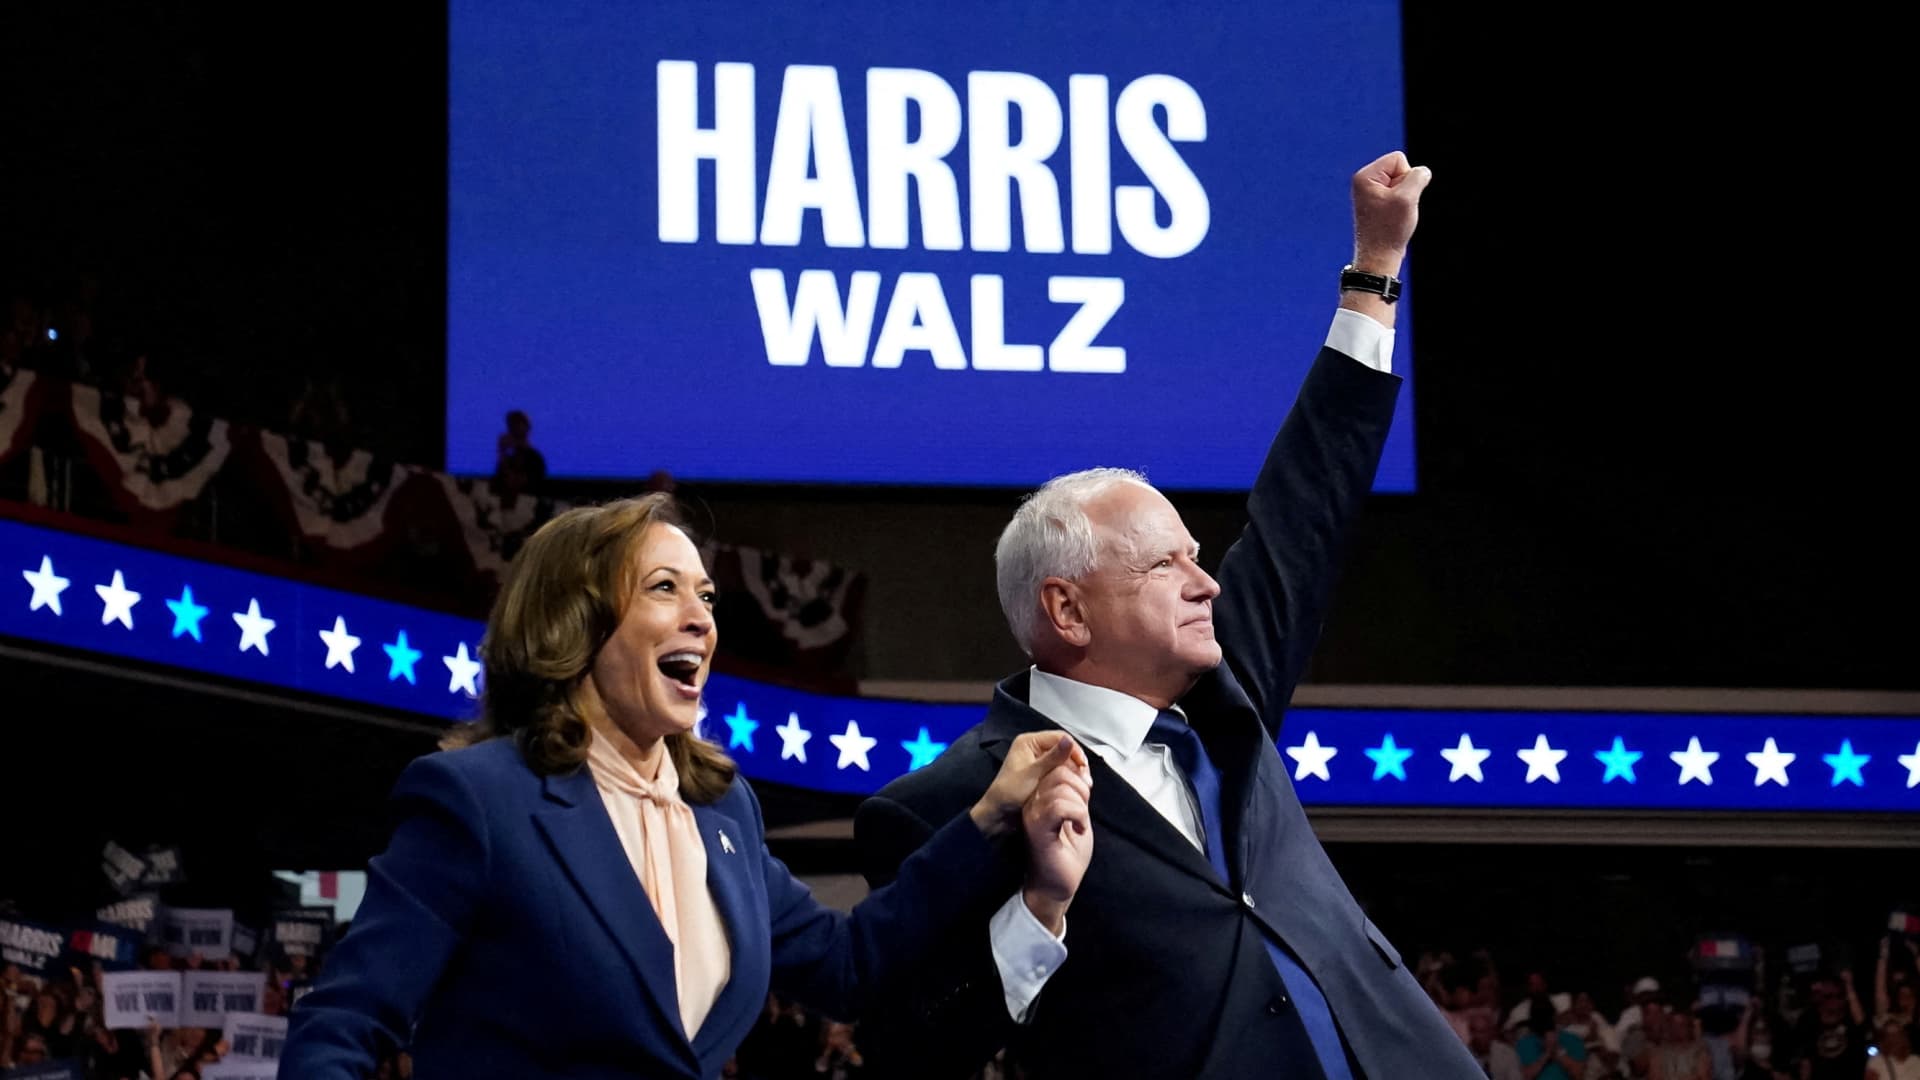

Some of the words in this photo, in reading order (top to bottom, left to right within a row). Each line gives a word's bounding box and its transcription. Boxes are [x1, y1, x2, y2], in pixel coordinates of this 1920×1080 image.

[656, 59, 1210, 258] HARRIS
[750, 268, 1127, 374] WALZ
[115, 992, 139, 1013] WE
[143, 991, 175, 1012] WIN
[193, 991, 218, 1012] WE
